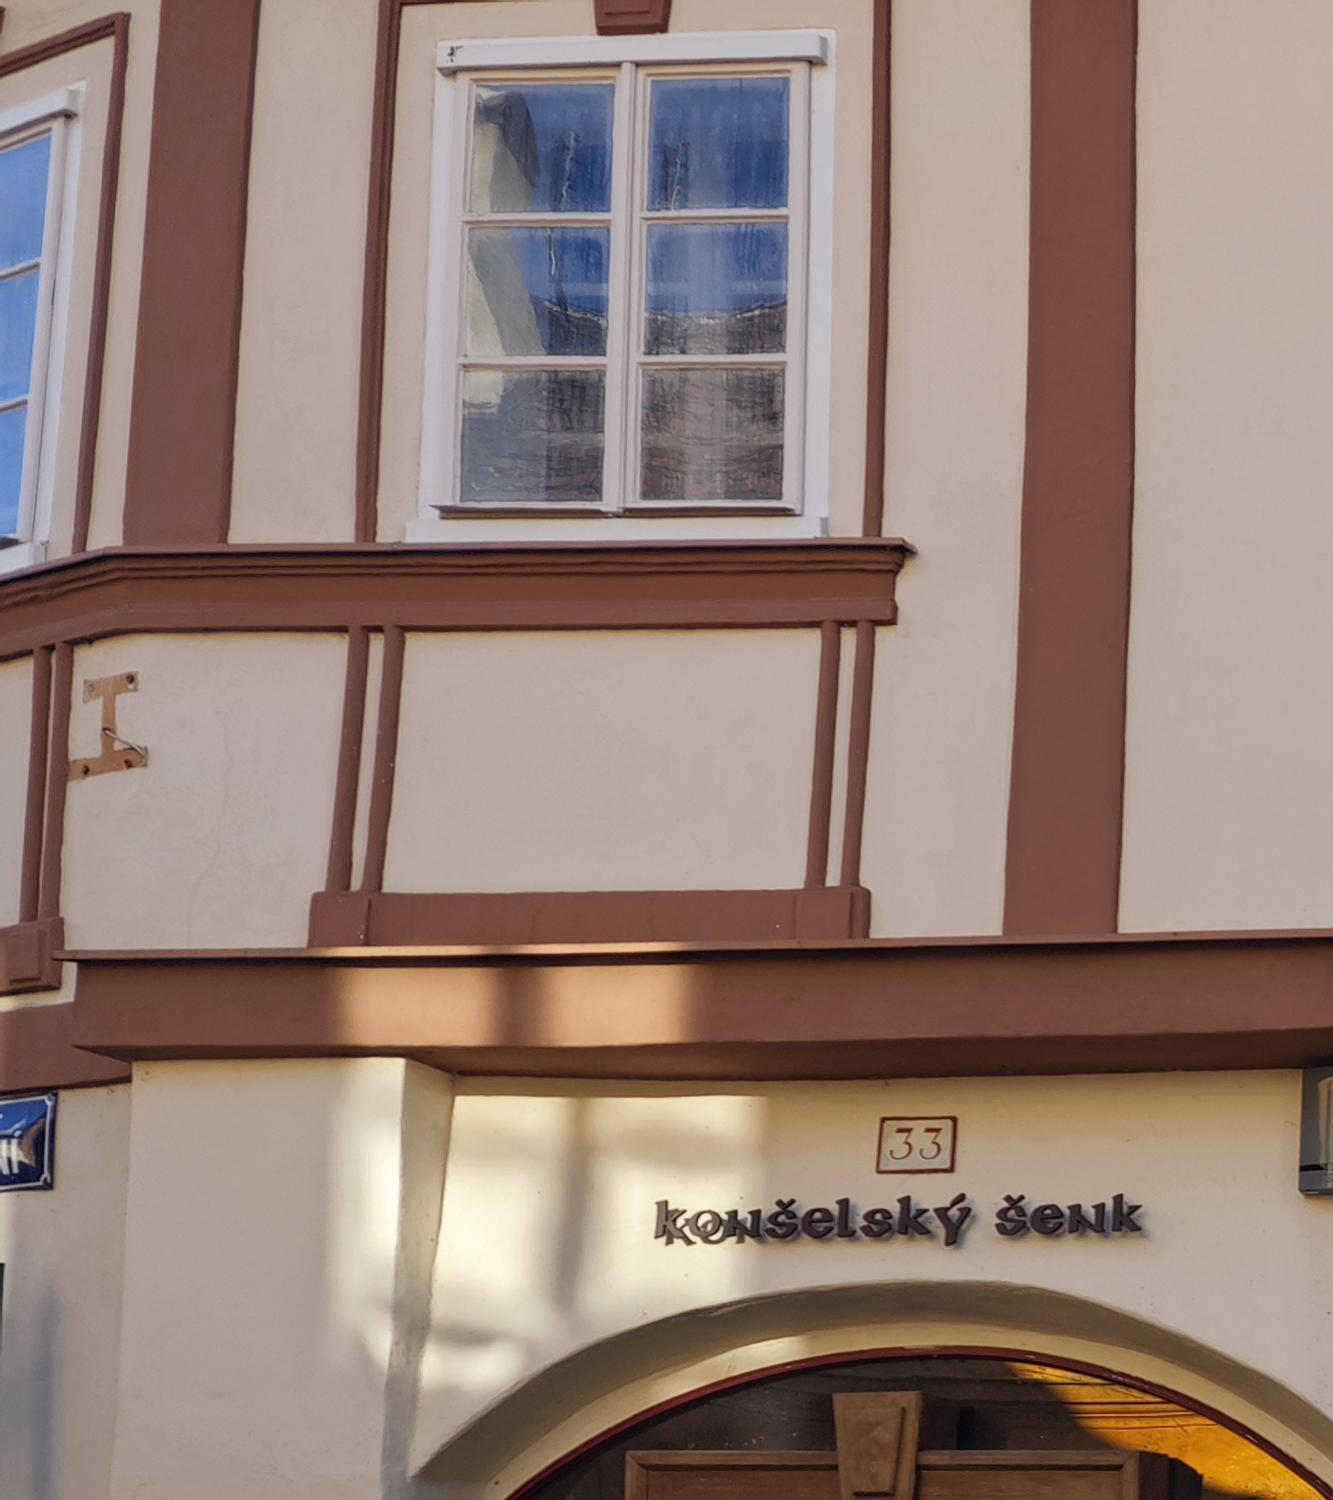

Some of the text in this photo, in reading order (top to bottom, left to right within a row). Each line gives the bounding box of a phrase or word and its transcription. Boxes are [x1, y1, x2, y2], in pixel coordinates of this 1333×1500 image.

[889, 1127, 944, 1160] 33
[654, 1193, 1143, 1247] konšelský šenk
